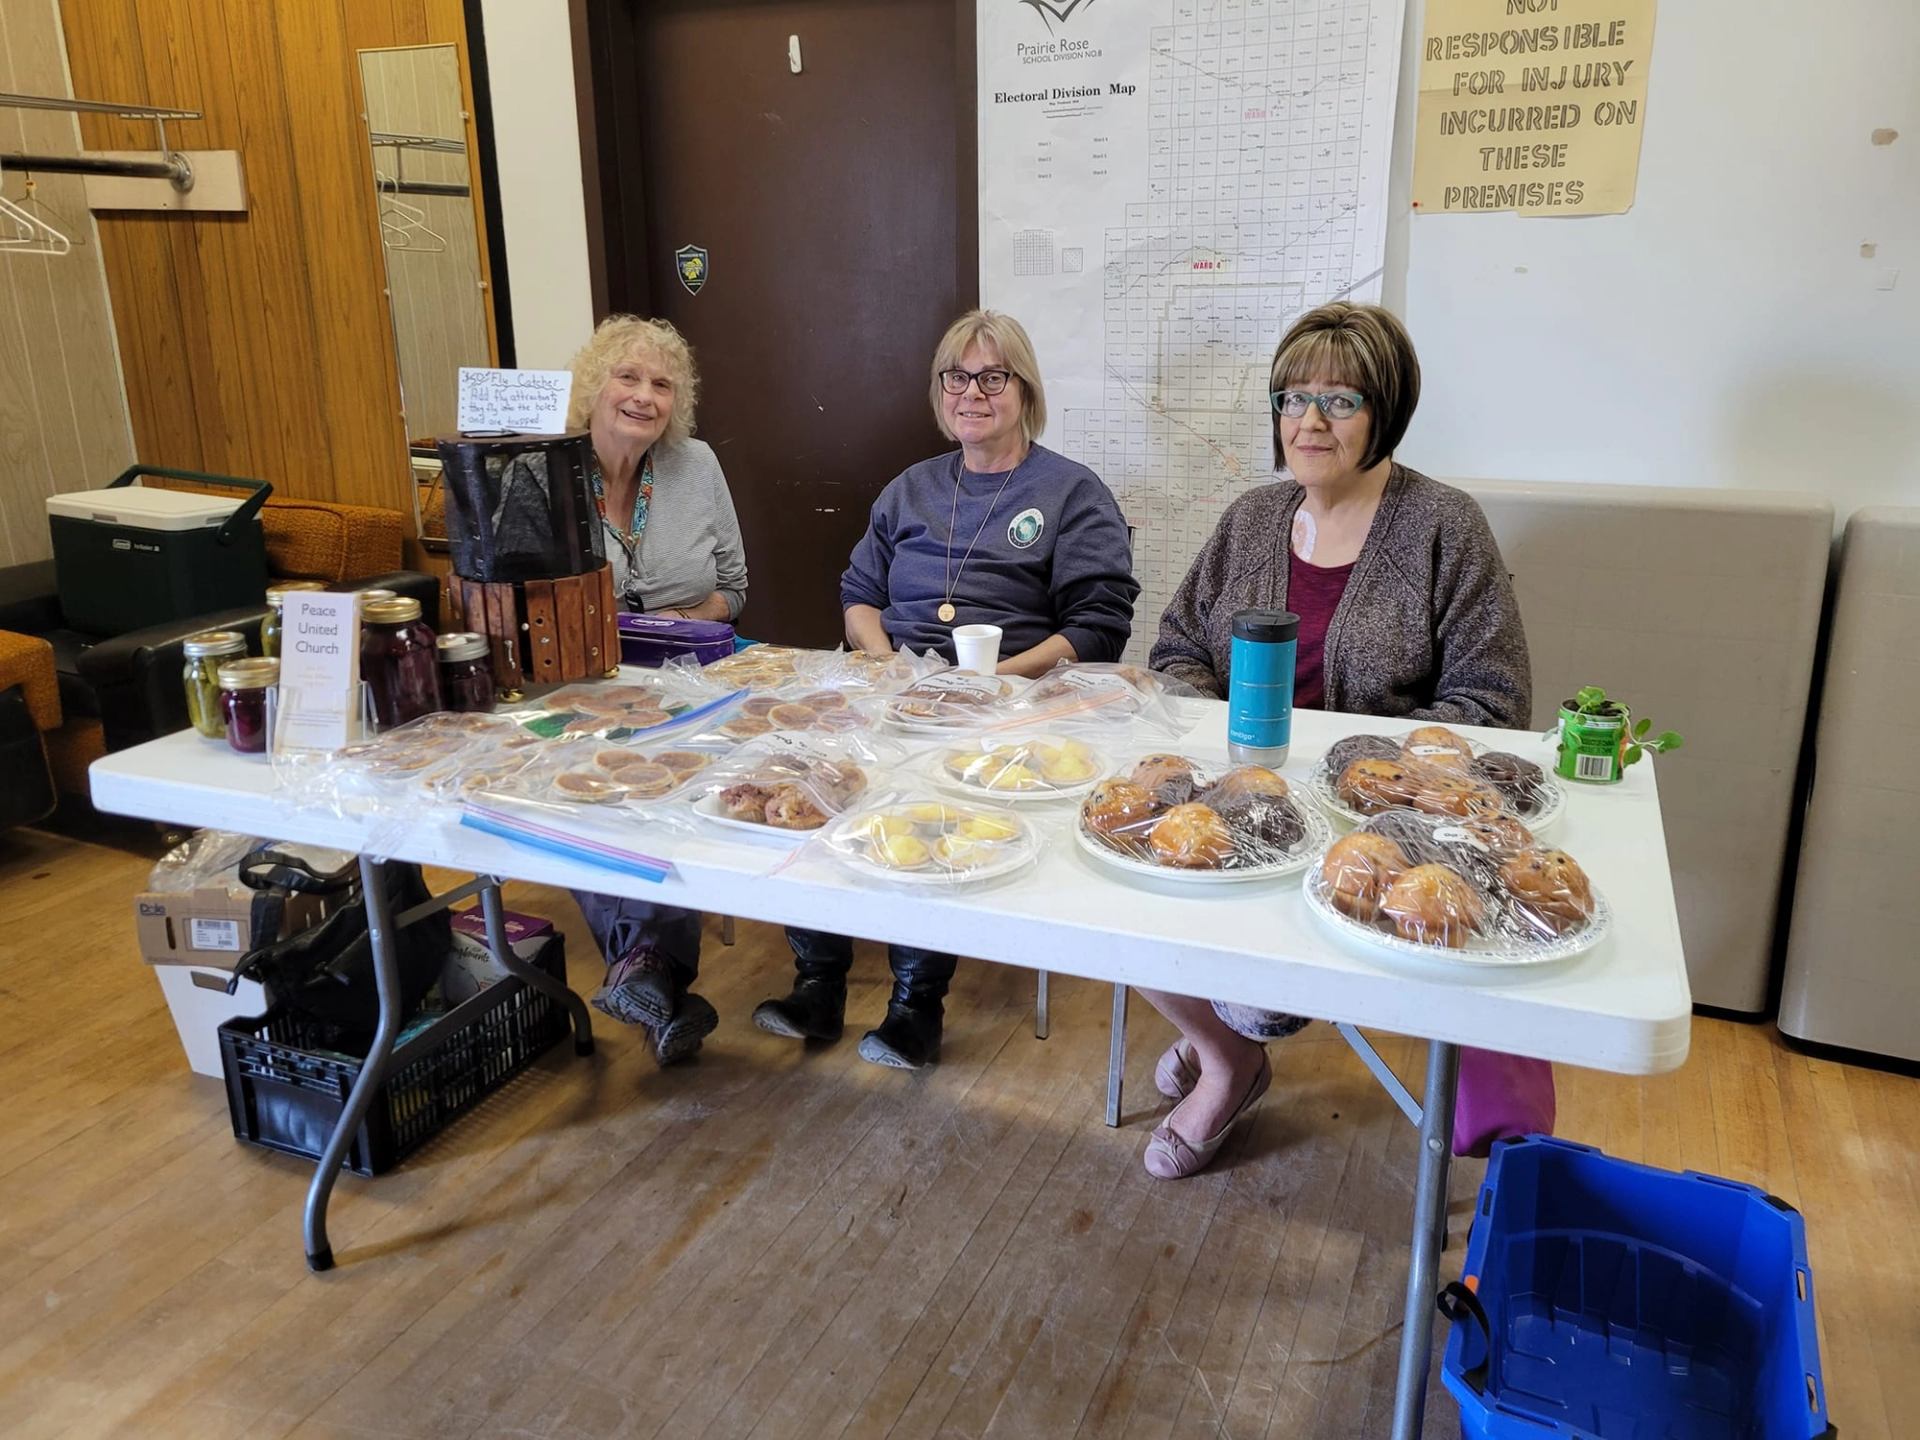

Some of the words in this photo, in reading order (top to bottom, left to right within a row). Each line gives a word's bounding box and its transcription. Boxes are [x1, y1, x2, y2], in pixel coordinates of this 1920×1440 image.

[1017, 42, 1056, 56] Prairie
[1060, 38, 1089, 52] Rose
[1426, 20, 1626, 61] RESPONSIBLE
[1022, 55, 1051, 64] SCHOOL
[1053, 52, 1084, 62] DIVISION
[1453, 69, 1505, 96] FOR
[1522, 60, 1634, 91] INJURY
[994, 89, 1048, 104] Electoral
[1052, 85, 1101, 100] Division
[1109, 83, 1136, 96] Map
[1440, 103, 1581, 135] INCURRED
[1594, 100, 1637, 126] ON
[1479, 143, 1568, 171] THESE
[1444, 180, 1585, 209] PREMISES
[1193, 262, 1213, 270] WARD
[301, 603, 337, 617] Peace
[298, 622, 338, 636] United
[295, 640, 339, 655] Church
